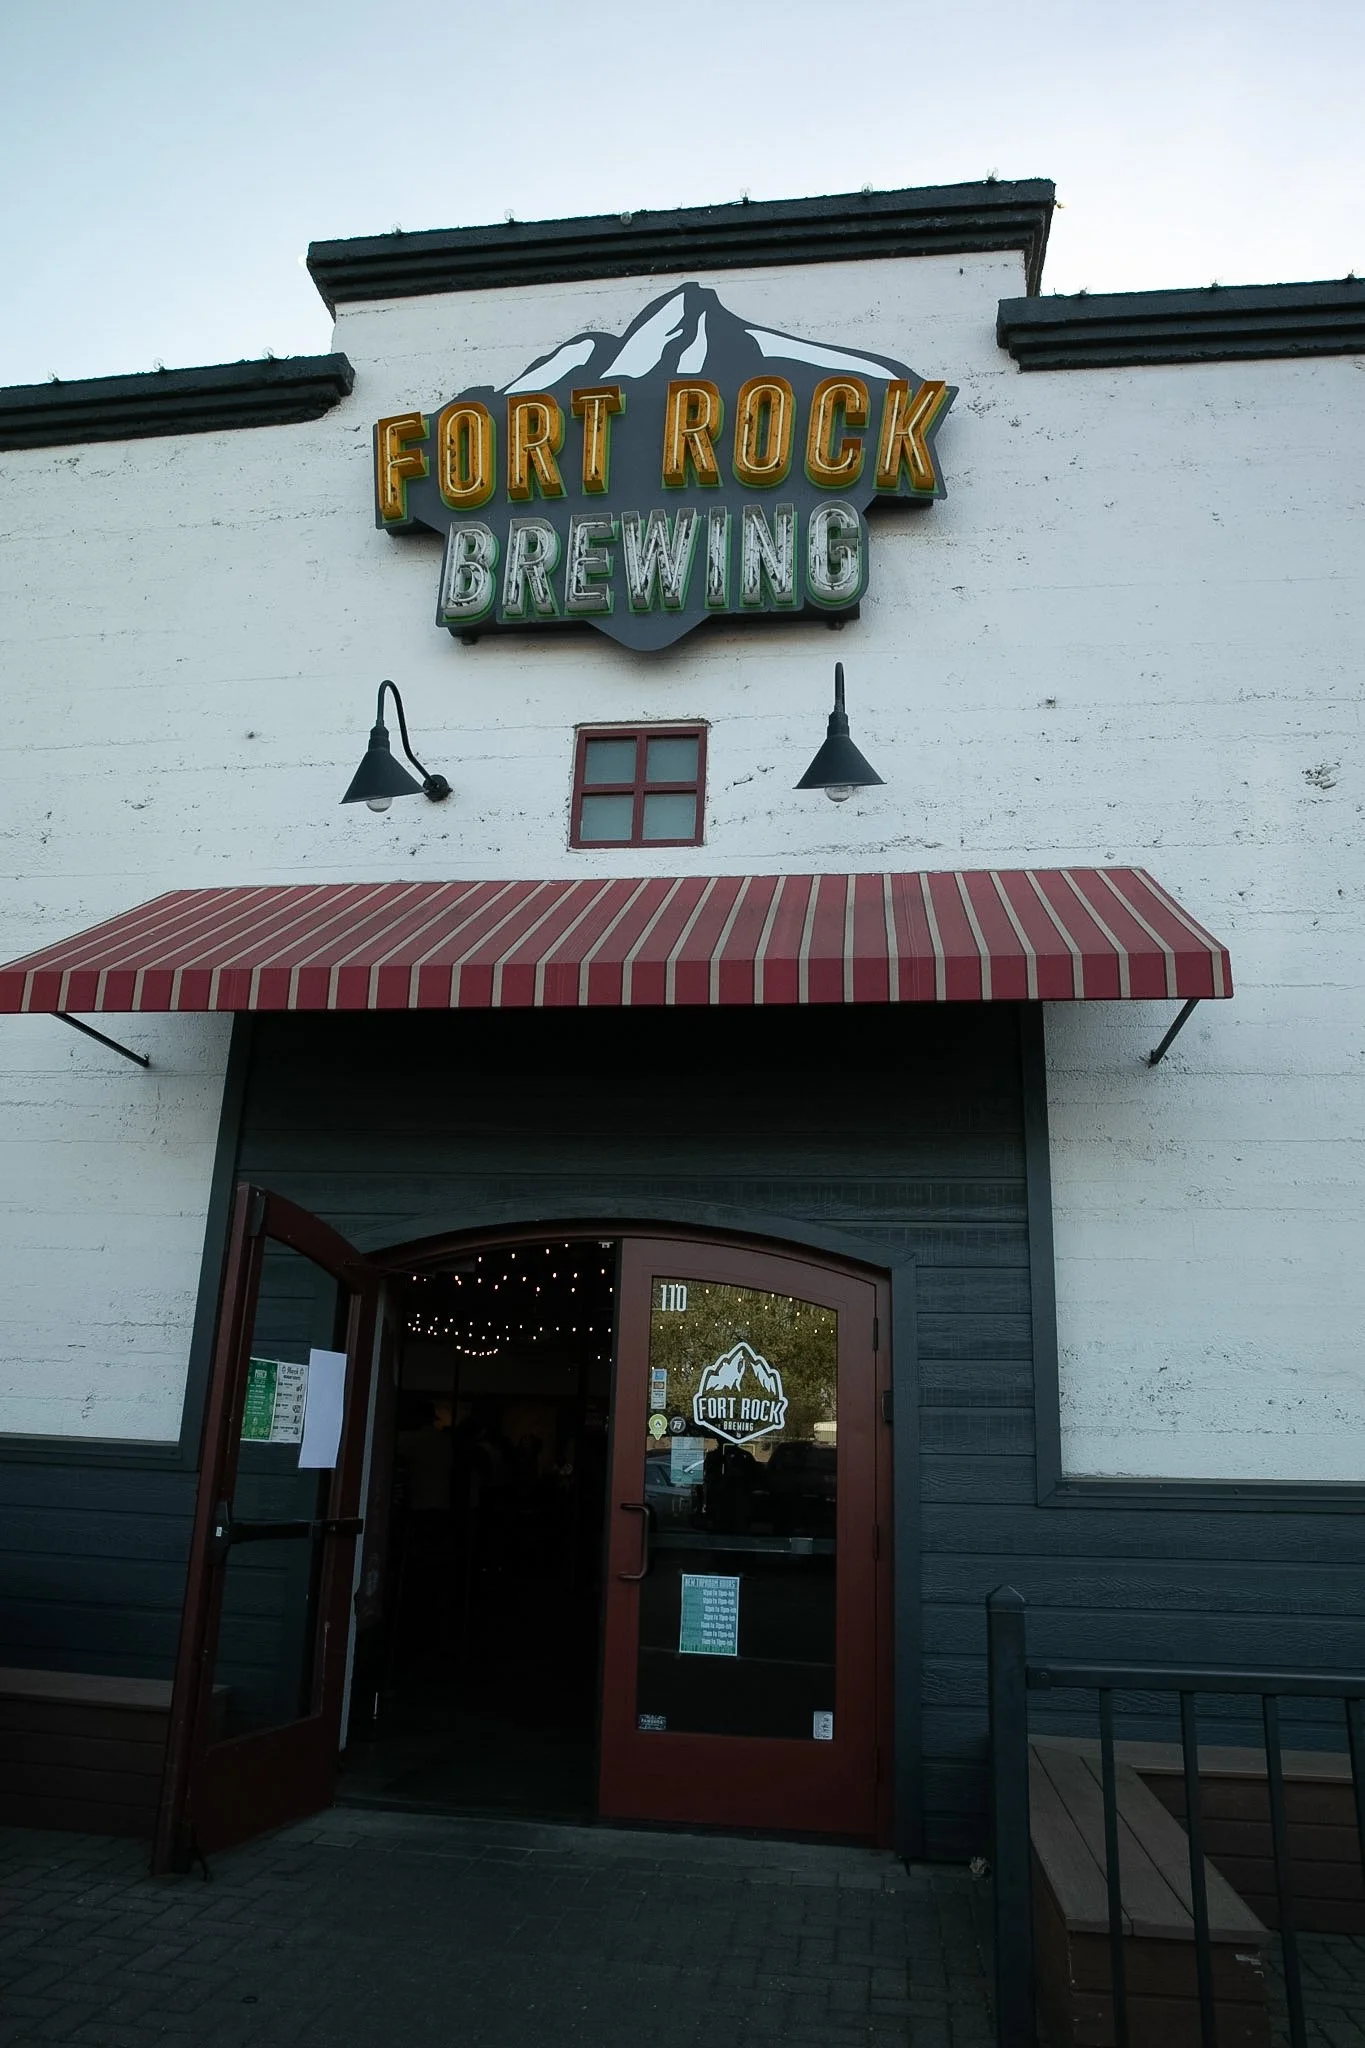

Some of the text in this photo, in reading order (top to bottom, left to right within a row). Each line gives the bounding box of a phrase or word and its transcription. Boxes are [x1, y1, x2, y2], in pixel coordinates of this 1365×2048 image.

[377, 375, 947, 521] FORT ROCK
[441, 500, 862, 619] BREWING
[660, 1284, 687, 1312] 110
[699, 1397, 782, 1424] FORT ROCK
[723, 1420, 754, 1432] BREWING
